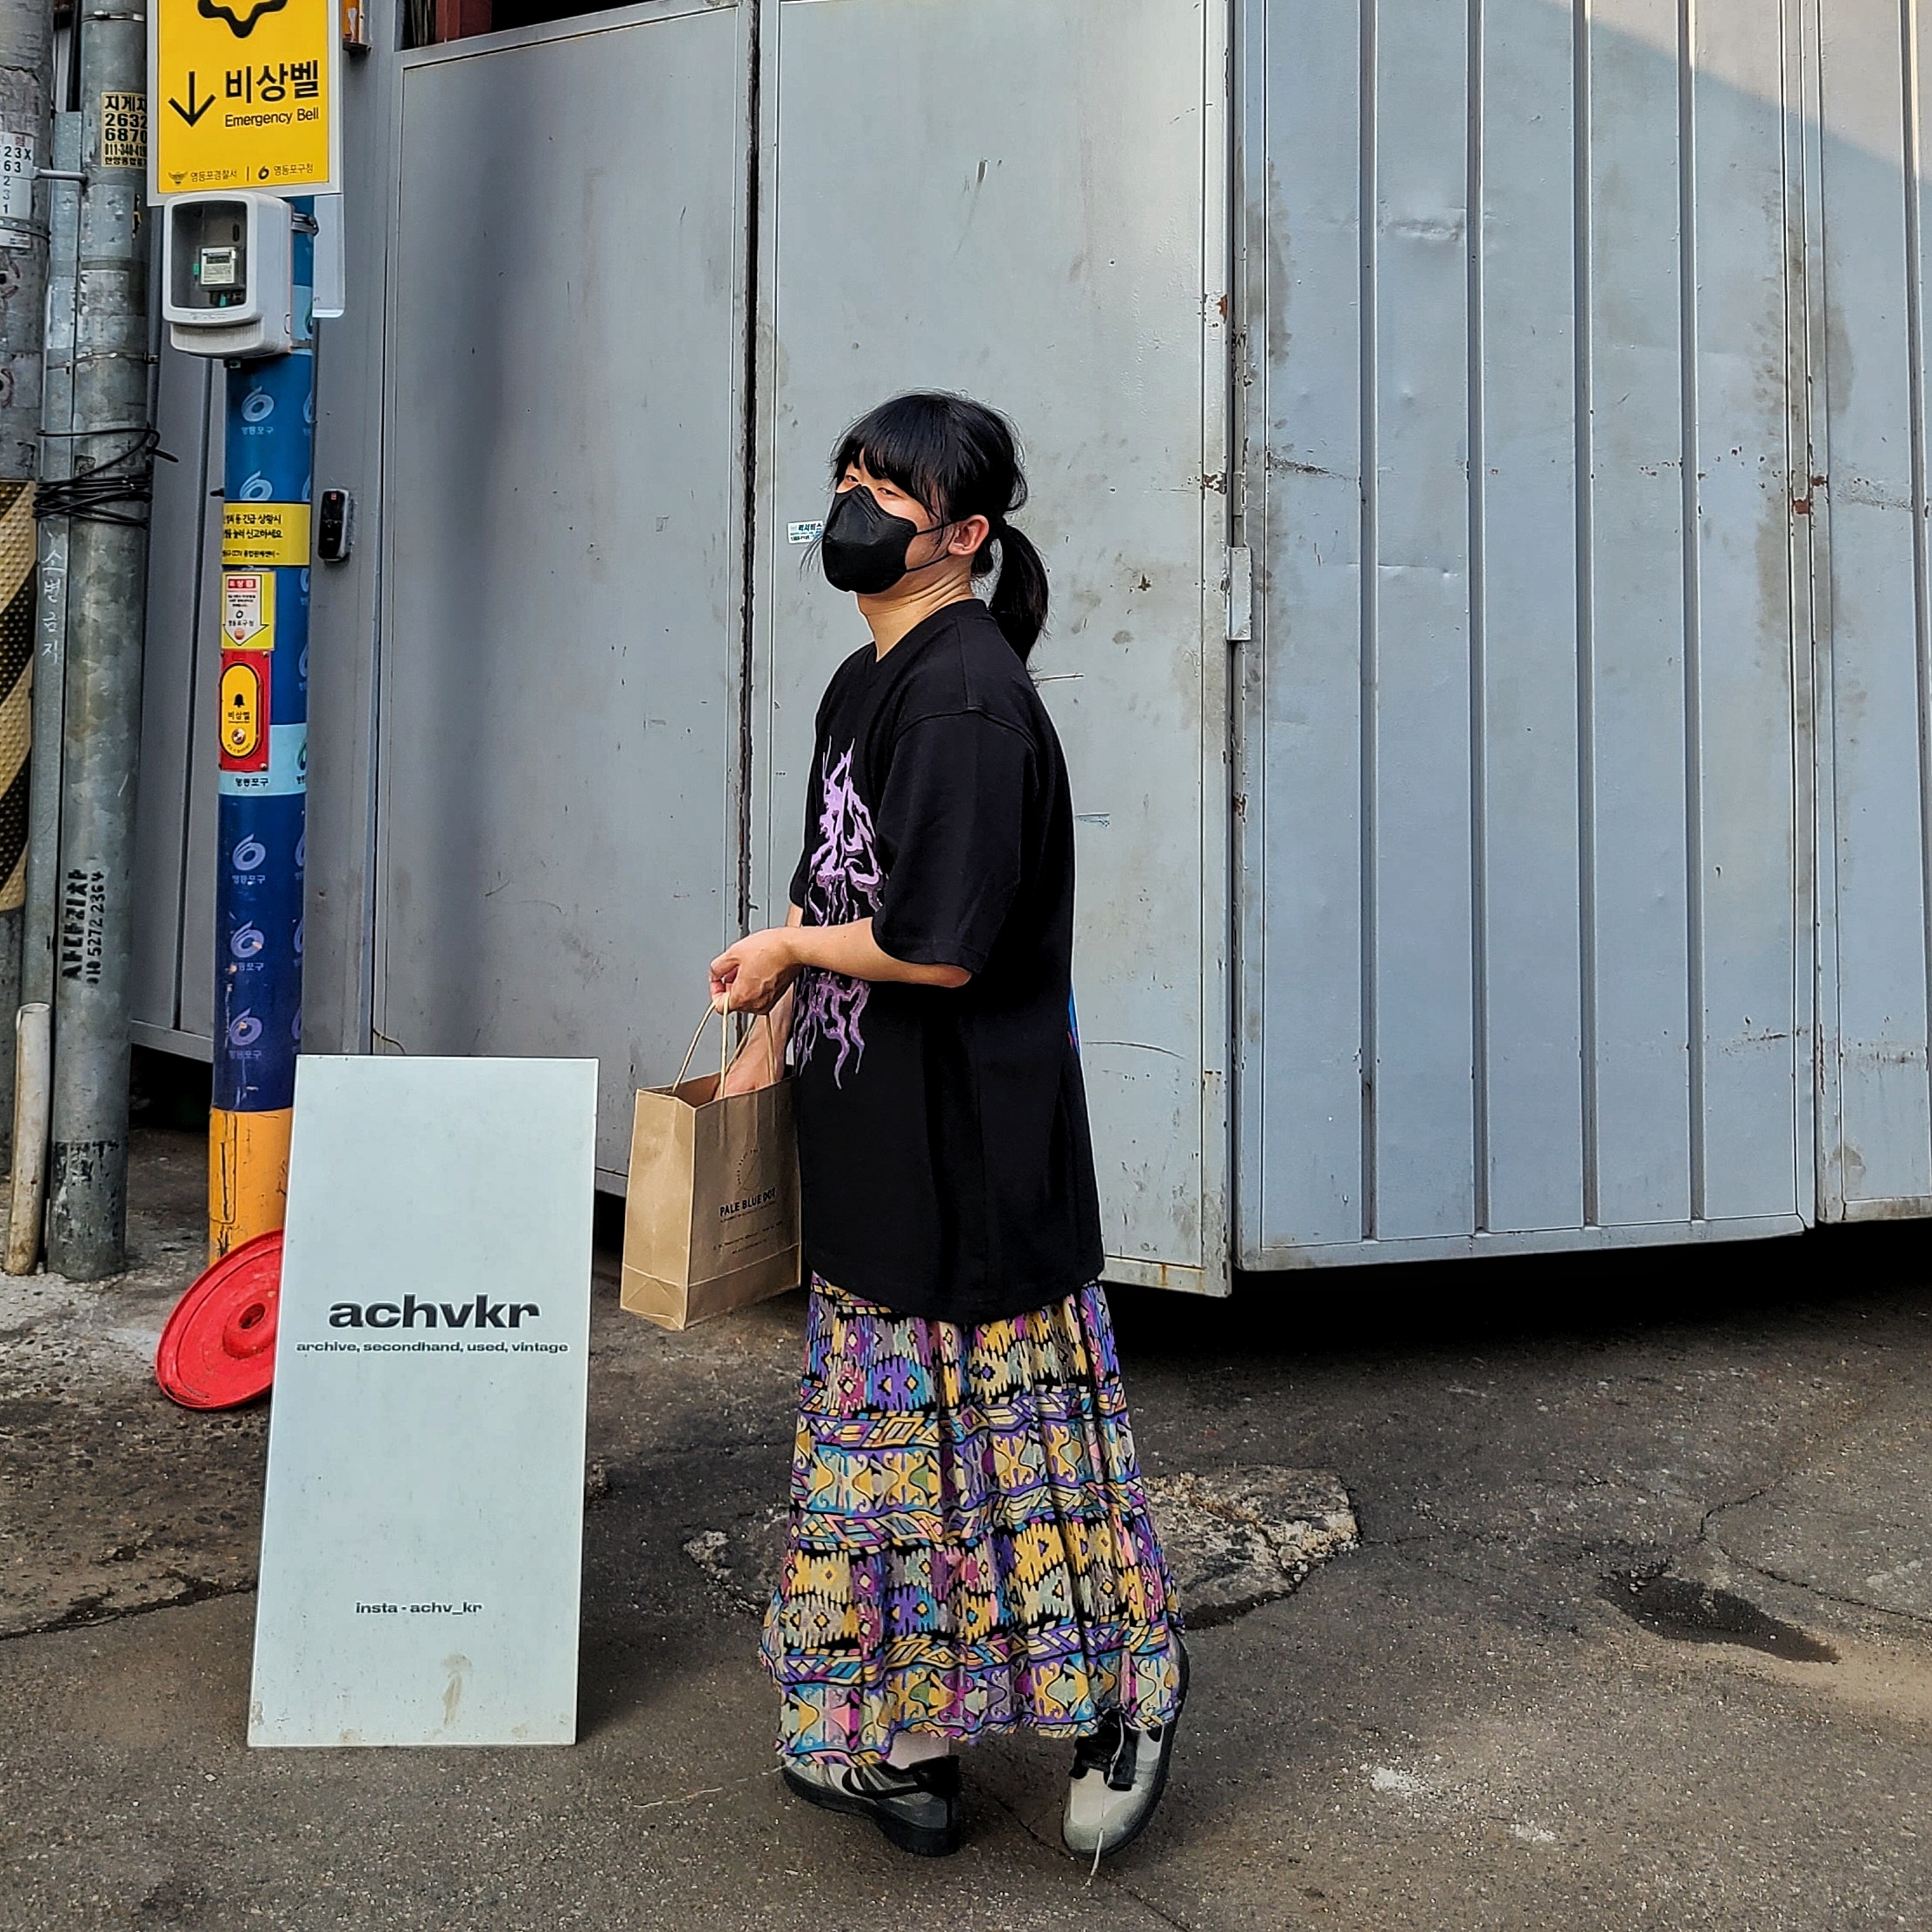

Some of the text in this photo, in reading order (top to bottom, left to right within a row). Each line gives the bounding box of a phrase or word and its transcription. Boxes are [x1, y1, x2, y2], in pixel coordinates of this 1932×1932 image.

[225, 59, 319, 103] 비상벨
[104, 113, 147, 129] 2632
[225, 107, 319, 127] Emergency Bell
[105, 128, 147, 143] 6870
[190, 170, 237, 182] 영등포경찰서
[274, 163, 313, 176] 영등포구청
[236, 777, 269, 787] 영등포구
[720, 1201, 740, 1217] PALE
[742, 1194, 761, 1210] BLUE
[329, 1293, 541, 1329] achvkr
[296, 1341, 568, 1353] archive, secondhand, used, vintage
[355, 1602, 398, 1613] insta
[409, 1602, 482, 1616] achv_kr
